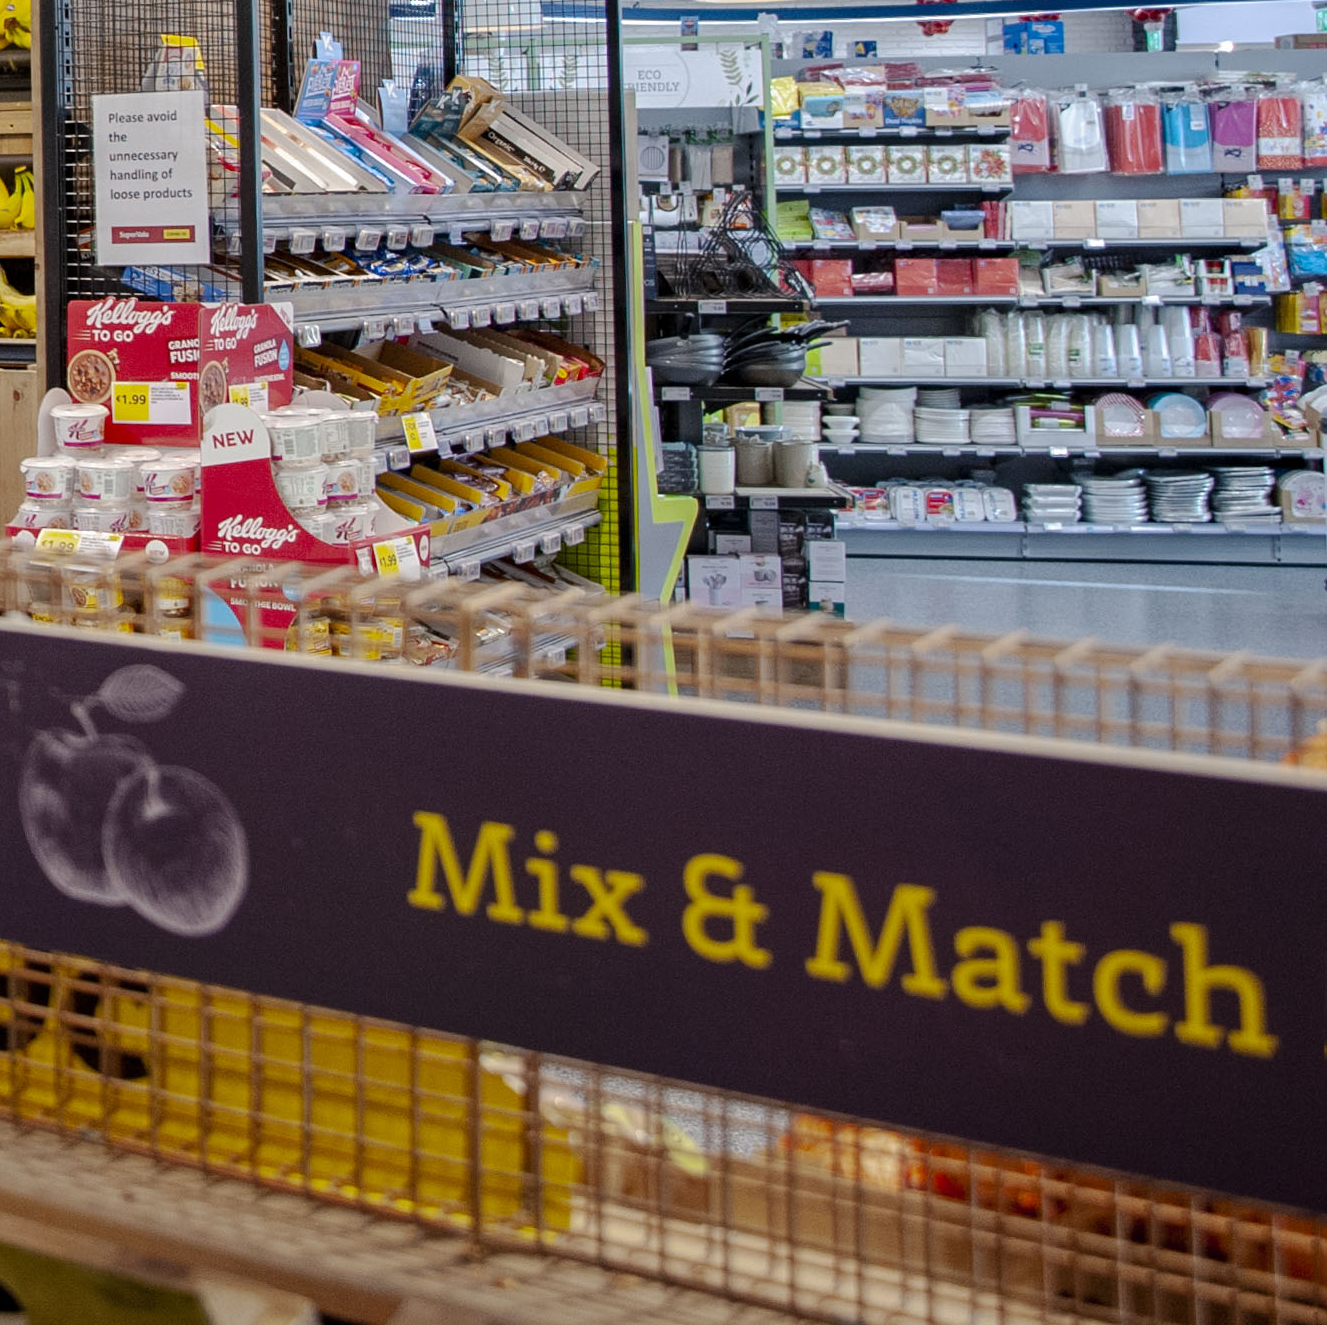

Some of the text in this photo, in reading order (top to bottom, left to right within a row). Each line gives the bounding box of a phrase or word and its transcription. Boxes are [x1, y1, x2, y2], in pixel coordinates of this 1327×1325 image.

[637, 69, 662, 81] ECO
[108, 110, 177, 124] Please avoid
[108, 132, 128, 143] the
[109, 150, 178, 162] unnecessary
[110, 168, 173, 182] handling of
[110, 187, 193, 202] loose products
[86, 298, 175, 334] Kellogg's
[210, 302, 258, 339] Kellogg's
[92, 329, 134, 342] TO GO
[168, 338, 200, 351] GRANO
[213, 338, 237, 351] TO GO
[170, 350, 200, 364] FUSI
[116, 393, 146, 405] €1.99
[212, 429, 255, 450] NEW
[218, 514, 300, 549] Kellogg's
[223, 542, 261, 555] TO GO
[407, 809, 1279, 1059] Mix & Match
